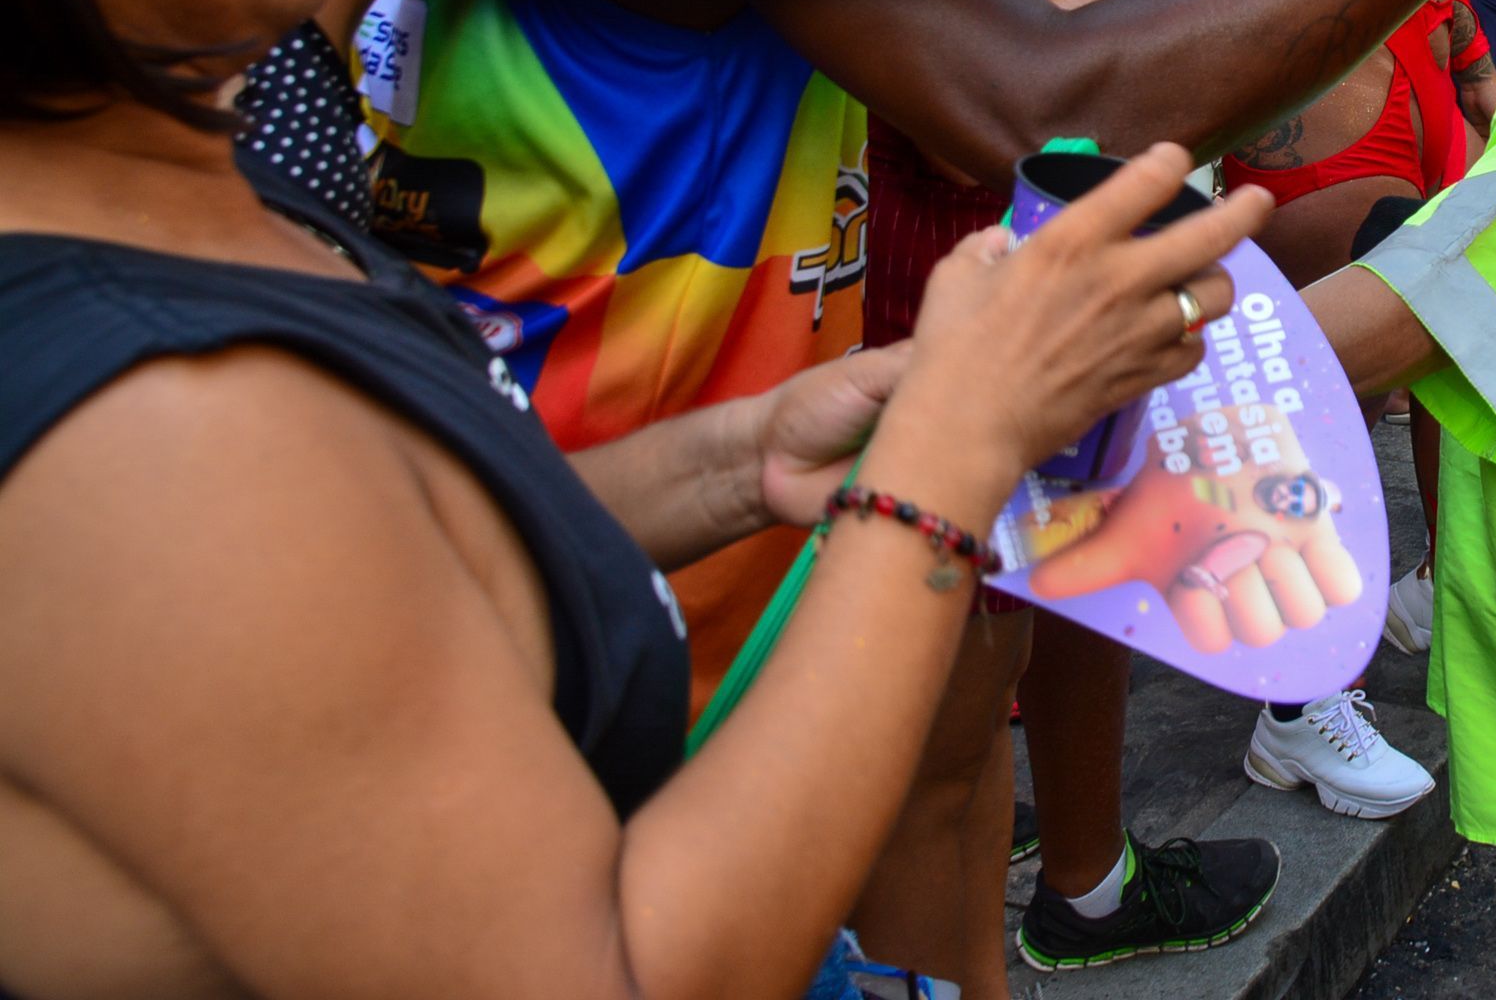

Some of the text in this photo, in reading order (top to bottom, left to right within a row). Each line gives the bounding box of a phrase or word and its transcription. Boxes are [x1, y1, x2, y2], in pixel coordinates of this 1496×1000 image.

[1209, 304, 1281, 466] antasia
[1242, 293, 1304, 414] Olha a
[1149, 386, 1191, 475] sabe
[1175, 362, 1242, 476] quem
